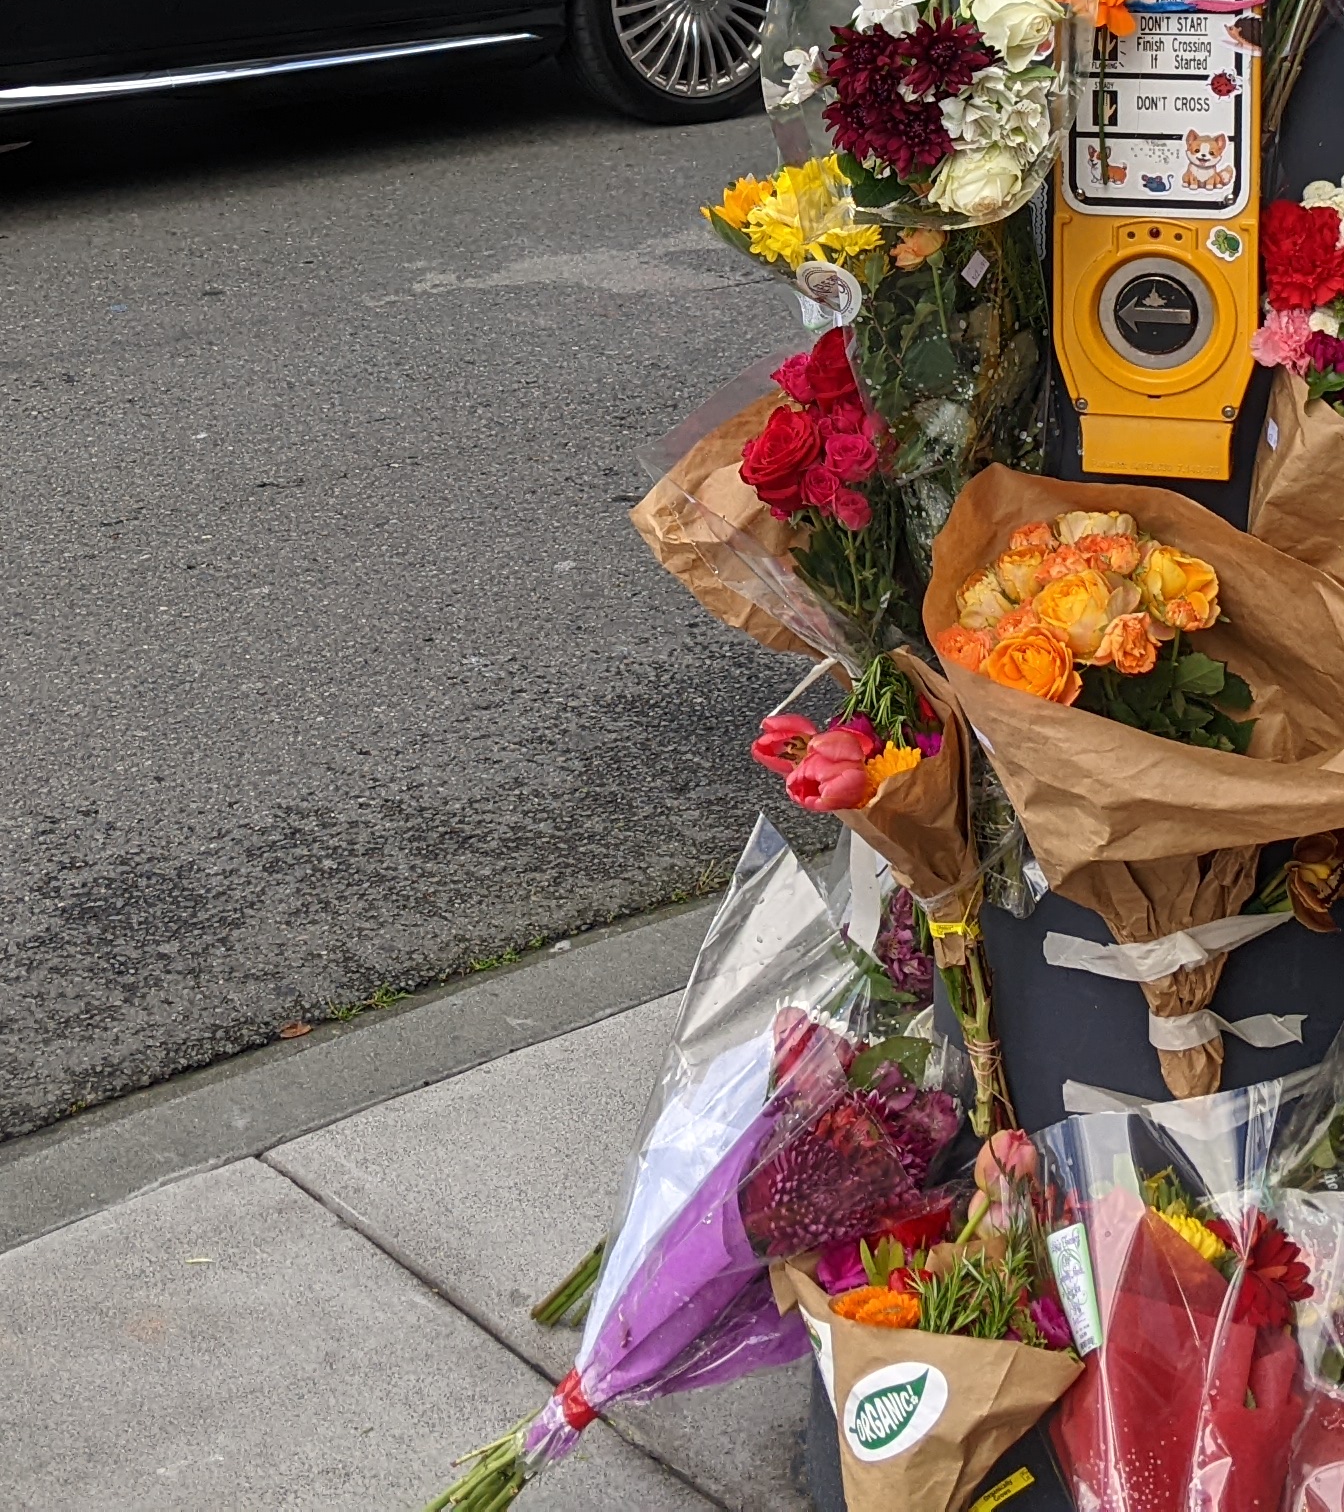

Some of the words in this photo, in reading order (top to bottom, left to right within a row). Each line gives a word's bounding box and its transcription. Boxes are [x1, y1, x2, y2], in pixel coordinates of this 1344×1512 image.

[1140, 16, 1171, 32] DON'T
[1177, 17, 1208, 32] START
[1136, 37, 1165, 52] Finish
[1172, 37, 1212, 57] Crossing
[1151, 54, 1158, 69] If
[1174, 54, 1208, 70] Started
[1136, 96, 1167, 111] DON'T
[1174, 97, 1210, 112] CROSS
[856, 1385, 918, 1442] ORGANIC!
